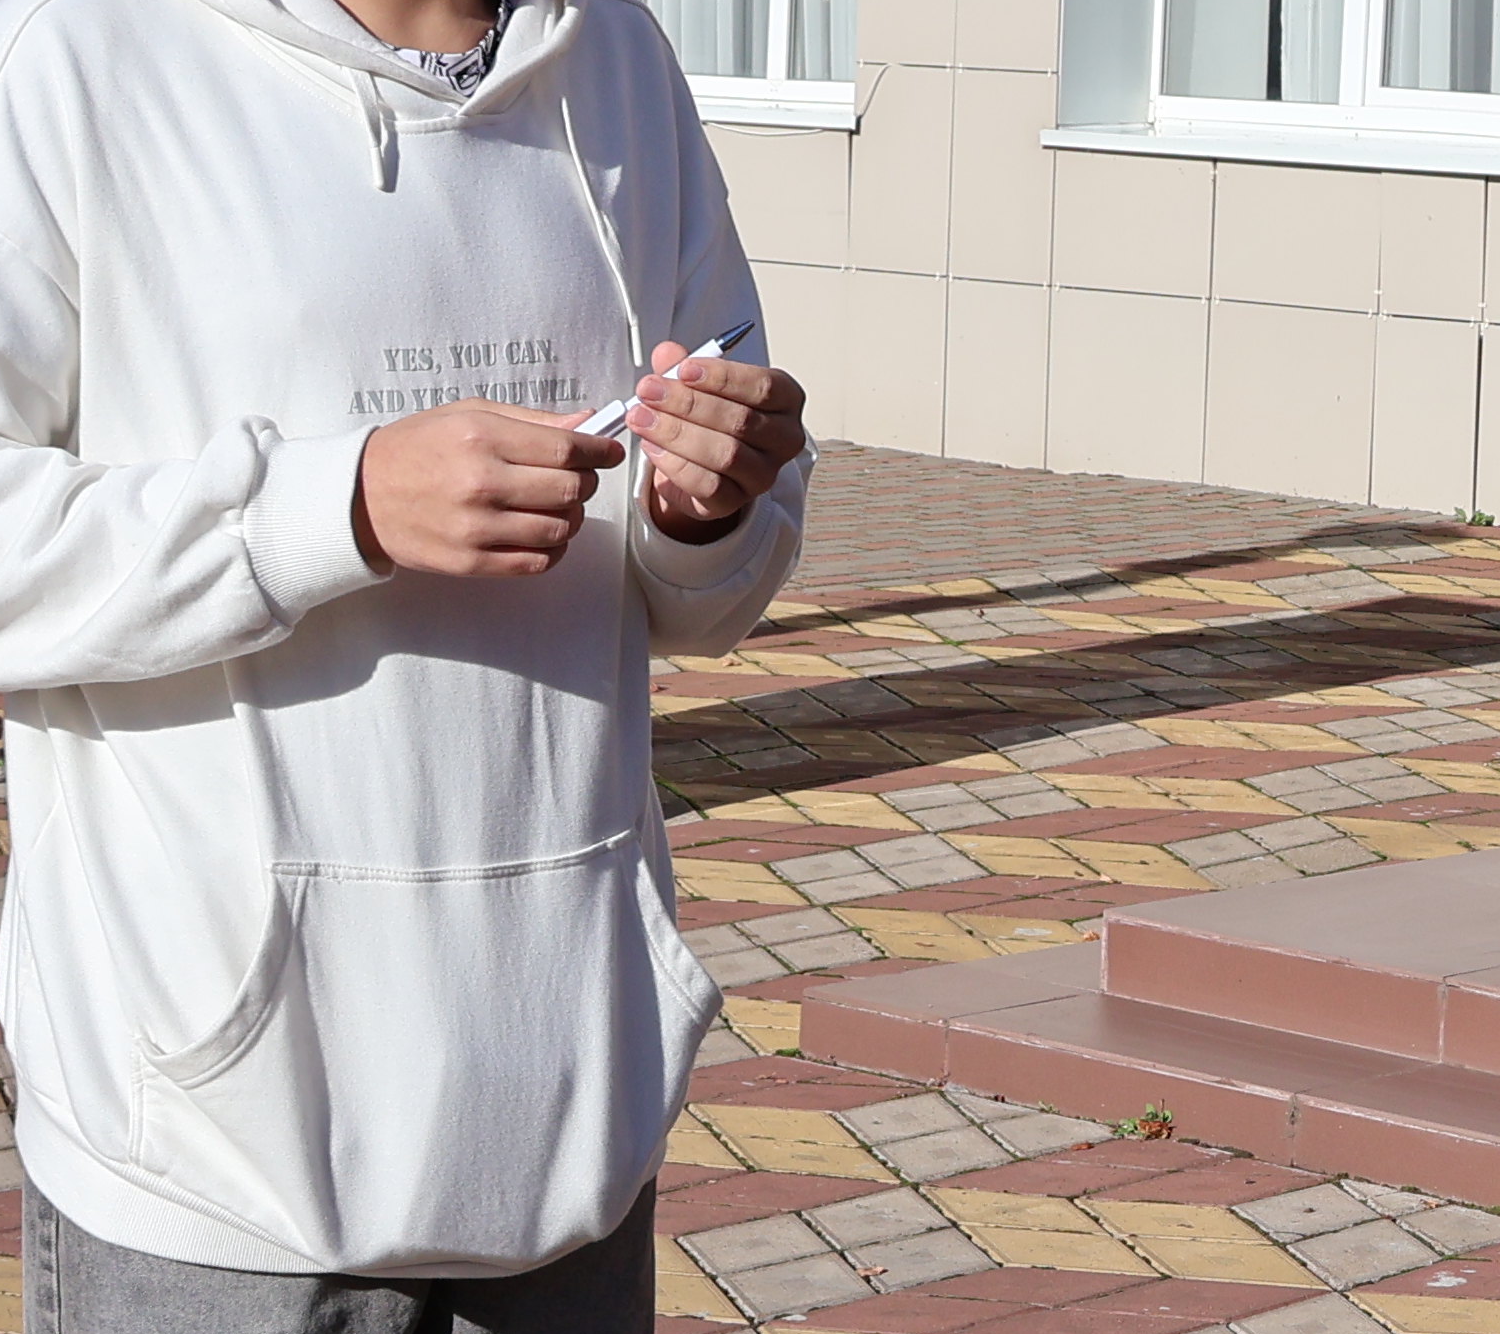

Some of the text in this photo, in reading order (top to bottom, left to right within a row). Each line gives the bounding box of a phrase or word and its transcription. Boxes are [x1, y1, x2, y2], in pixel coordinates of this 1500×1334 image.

[382, 338, 559, 375] YES, YOU CAN.
[347, 388, 407, 416] AND
[476, 380, 522, 405] YOU
[528, 378, 588, 402] WILL.
